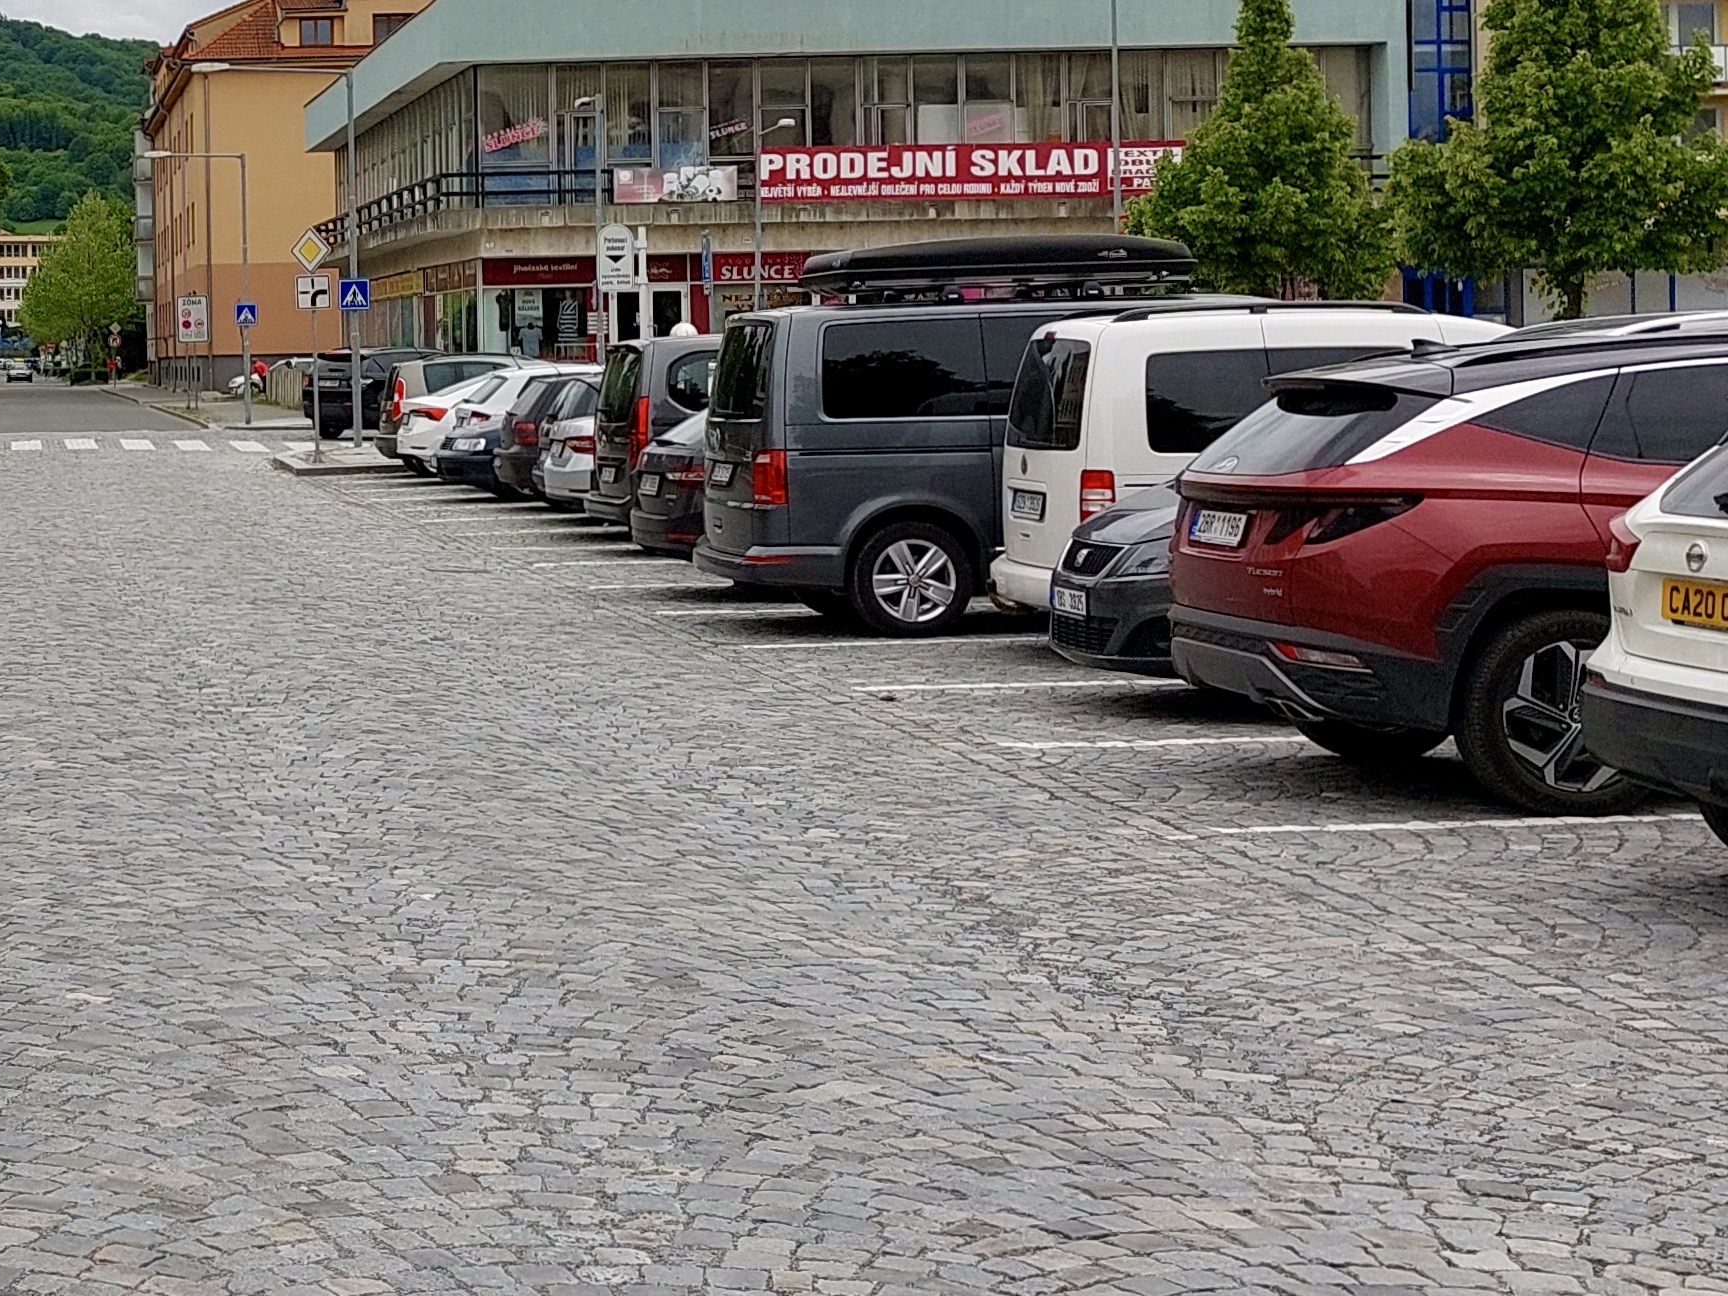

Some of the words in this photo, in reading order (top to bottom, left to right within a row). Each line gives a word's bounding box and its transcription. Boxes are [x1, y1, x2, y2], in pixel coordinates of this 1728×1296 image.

[710, 122, 748, 139] SLUNCE
[760, 146, 956, 180] PRODEJNÍ
[970, 148, 1099, 177] SKLAD
[881, 181, 918, 196] OBLEČENÍ
[920, 184, 934, 196] PRO
[937, 183, 962, 195] CELOU
[964, 182, 992, 195] RODINU
[999, 180, 1025, 194] KAŽDÝ
[1027, 180, 1052, 193] TÝDEN
[1055, 180, 1075, 193] NOVÉ
[1076, 178, 1100, 193] ZBOŽÍ
[720, 265, 795, 280] SLUNCE
[1197, 512, 1216, 534] 2BR
[1669, 585, 1716, 619] CA20
